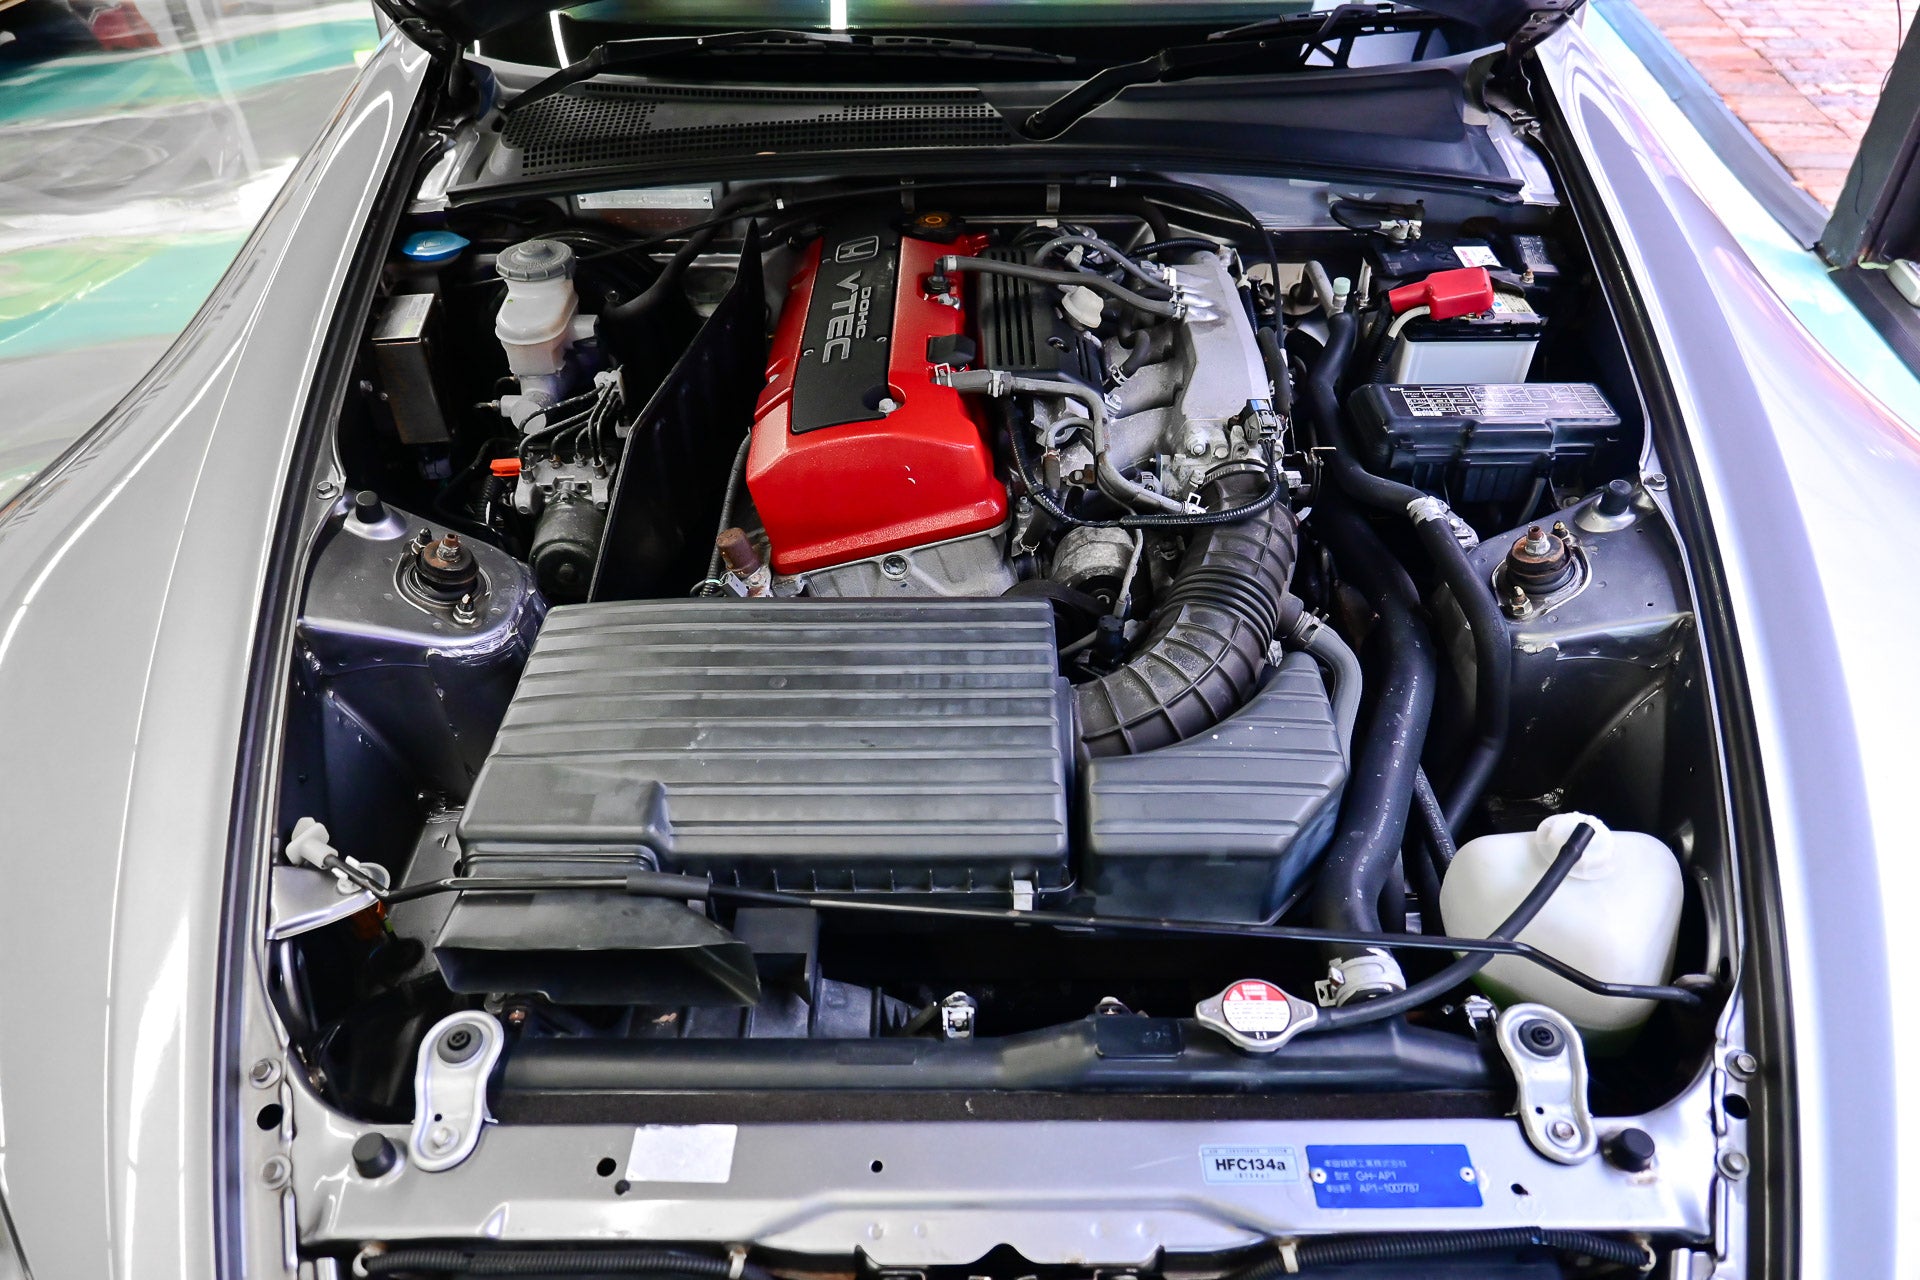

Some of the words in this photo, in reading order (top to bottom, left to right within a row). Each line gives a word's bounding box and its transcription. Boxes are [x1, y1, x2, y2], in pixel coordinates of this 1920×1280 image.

[822, 269, 862, 364] VTEC
[855, 286, 872, 339] DOHC
[1215, 1158, 1286, 1171] HFC134a
[1355, 1170, 1397, 1181] GH-AP1
